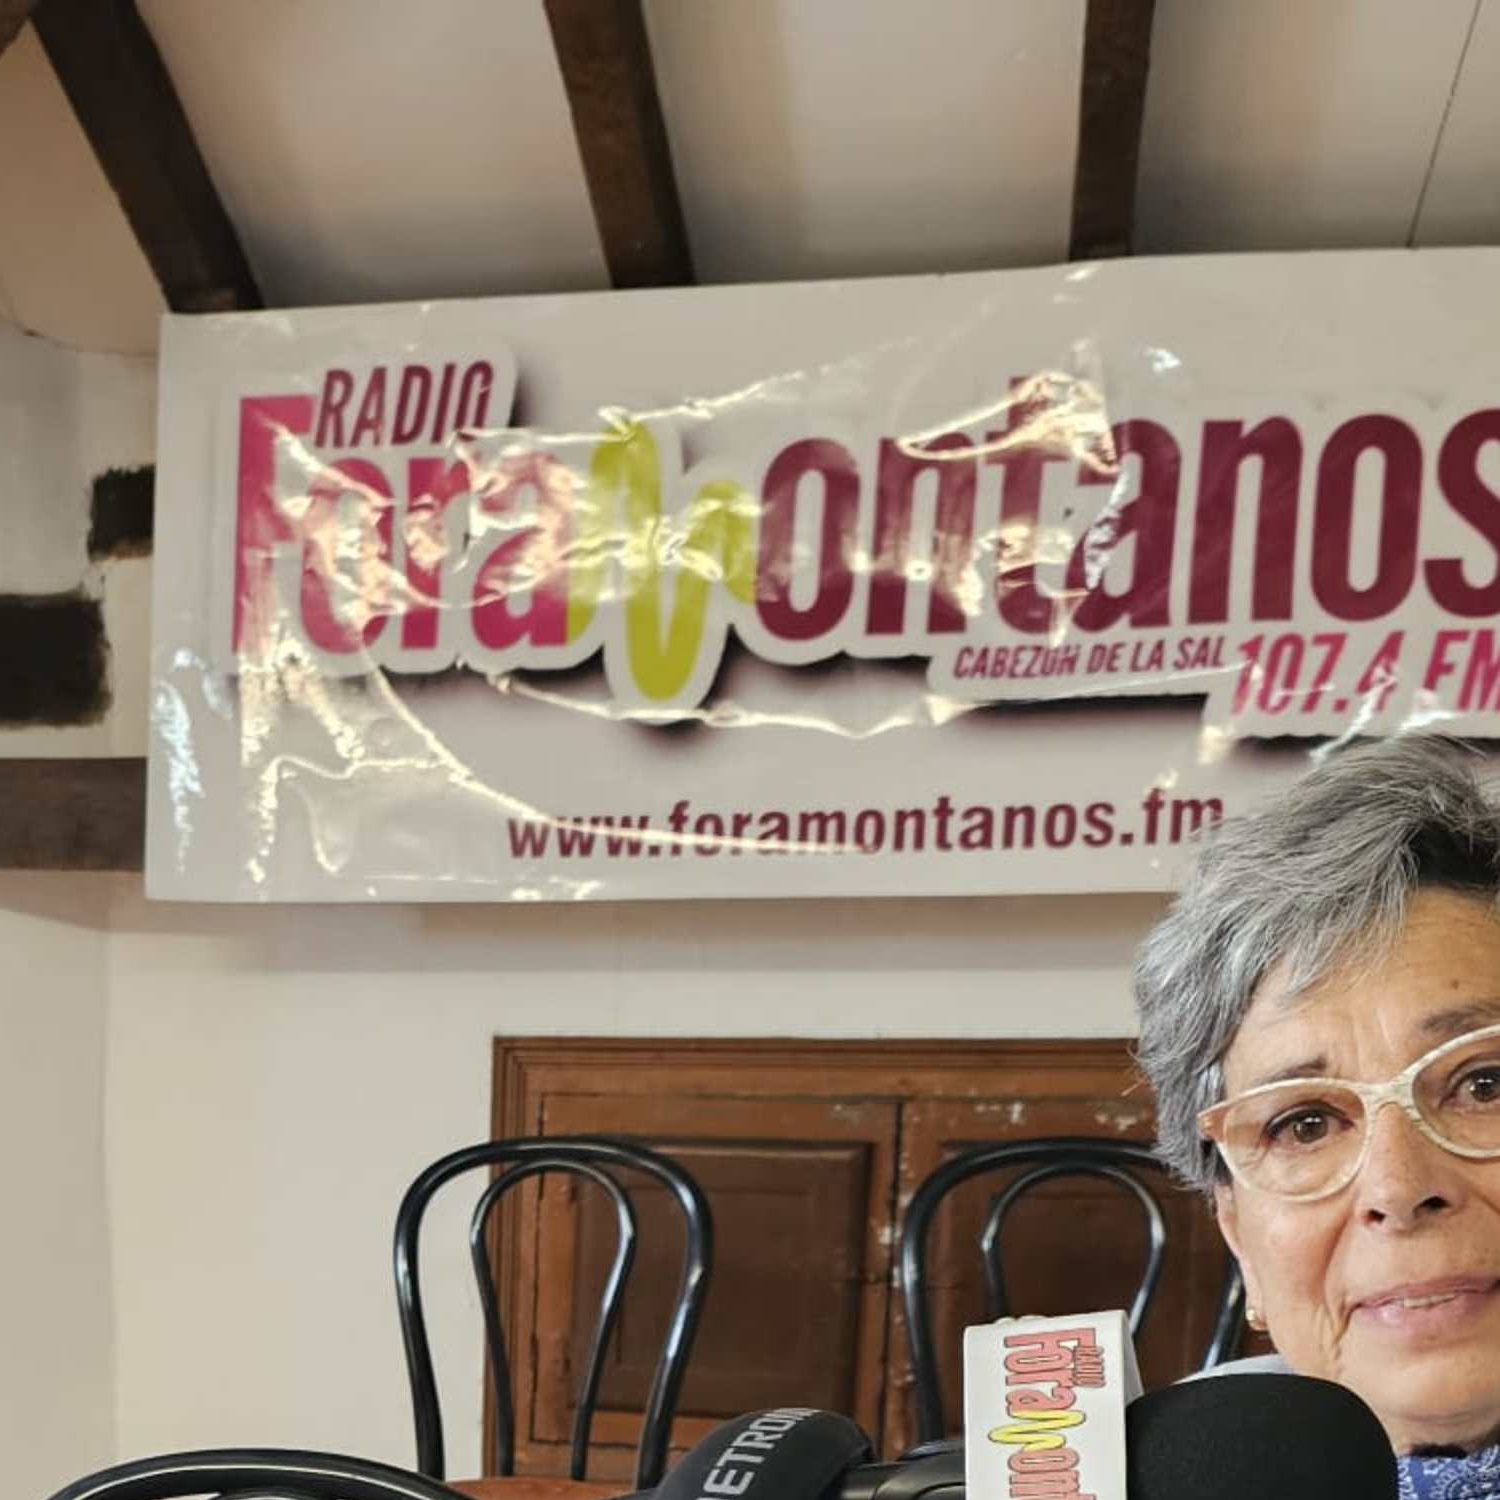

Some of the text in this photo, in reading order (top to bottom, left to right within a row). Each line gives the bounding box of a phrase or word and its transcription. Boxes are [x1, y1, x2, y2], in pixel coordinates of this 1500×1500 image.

[314, 360, 495, 450] RADIO
[1086, 642, 1127, 675] DE
[1129, 638, 1166, 672] LA
[1172, 635, 1225, 669] SAL
[1230, 631, 1405, 715] 107.4
[508, 787, 1223, 859] www.foramontanos.fm
